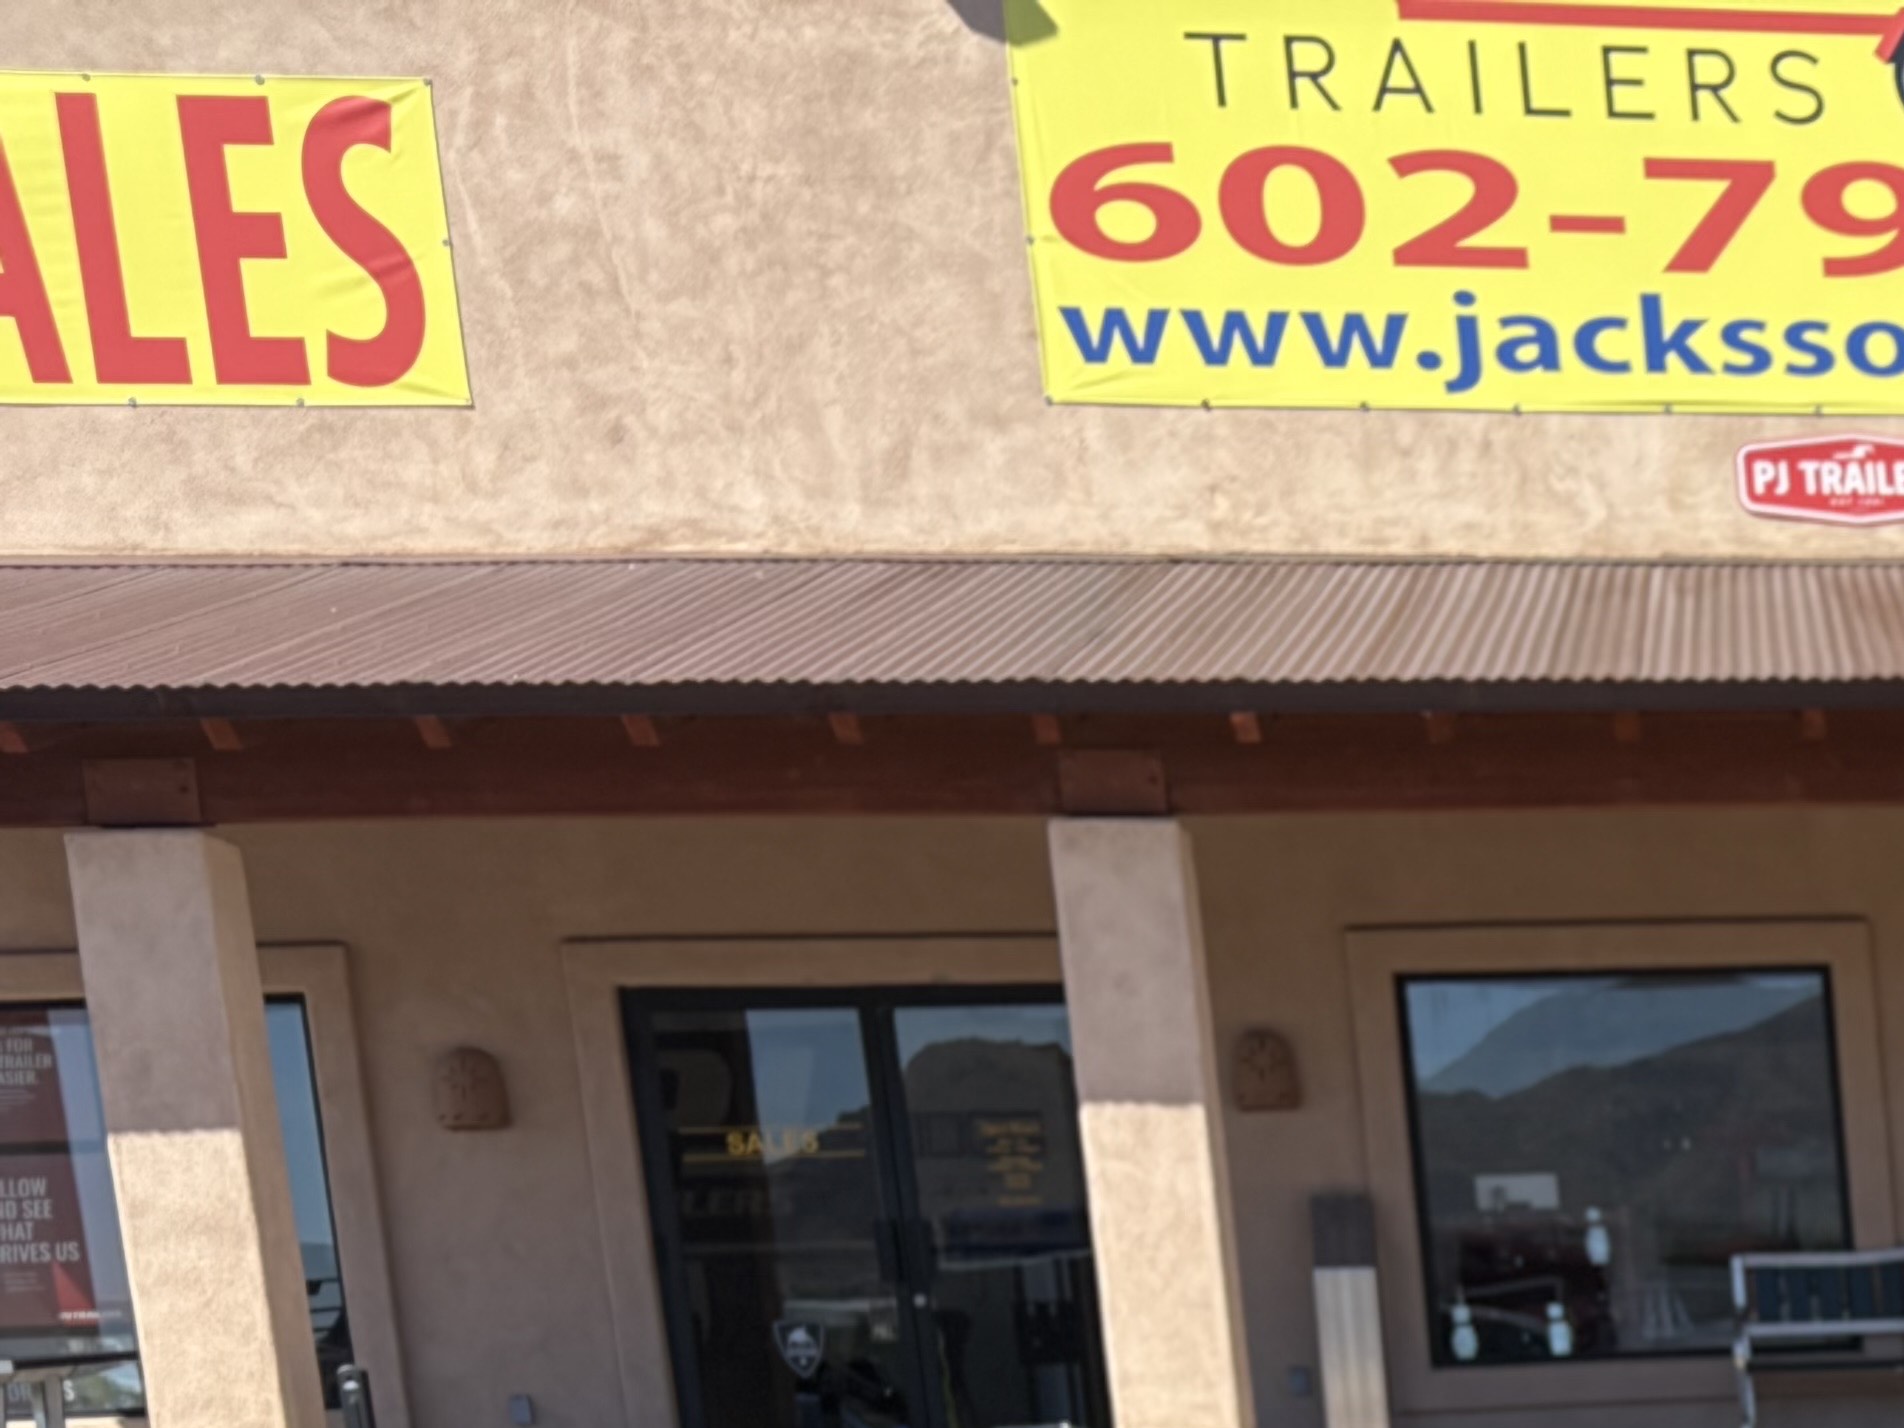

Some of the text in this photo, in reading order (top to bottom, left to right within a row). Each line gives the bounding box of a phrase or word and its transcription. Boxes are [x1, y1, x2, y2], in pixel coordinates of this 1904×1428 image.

[1184, 32, 1824, 125] TRAILERS
[1751, 459, 1790, 496] PJ
[727, 1129, 819, 1156] SALES
[22, 1199, 53, 1219] SEE
[55, 1241, 81, 1261] US
